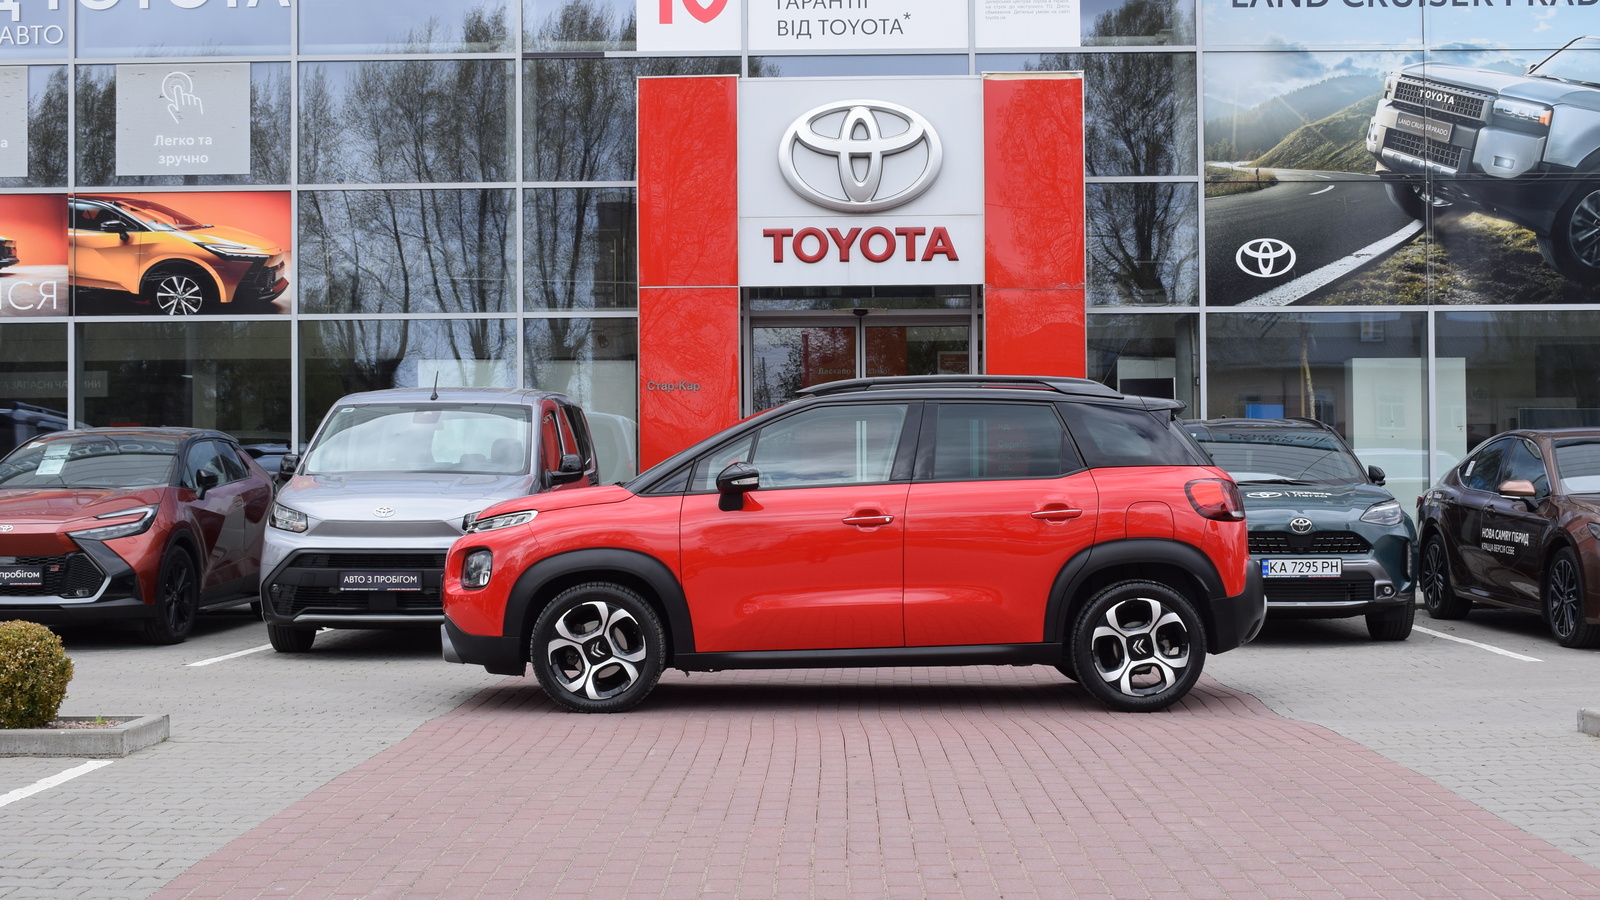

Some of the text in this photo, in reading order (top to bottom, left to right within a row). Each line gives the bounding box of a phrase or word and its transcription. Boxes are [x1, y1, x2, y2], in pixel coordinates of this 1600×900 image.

[0, 25, 64, 45] АВТО
[777, 19, 811, 40] ВІД
[1420, 89, 1454, 105] TOYOTA
[1397, 117, 1410, 126] LAND
[1431, 126, 1448, 136] PRADO
[153, 135, 213, 147] Легко та
[158, 154, 209, 167] зручно
[763, 226, 959, 263] TOYOTA
[0, 280, 57, 310] СЯ
[11, 381, 53, 390] ЗАПАСНІ
[55, 380, 102, 390] ЧАНИ
[646, 380, 701, 393] Стар-Кар
[1481, 528, 1495, 539] НОВА
[1269, 561, 1339, 574] KA 7295 PH
[0, 569, 40, 580] пробігом
[343, 575, 418, 584] АВТО З ПРОБІГОМ
